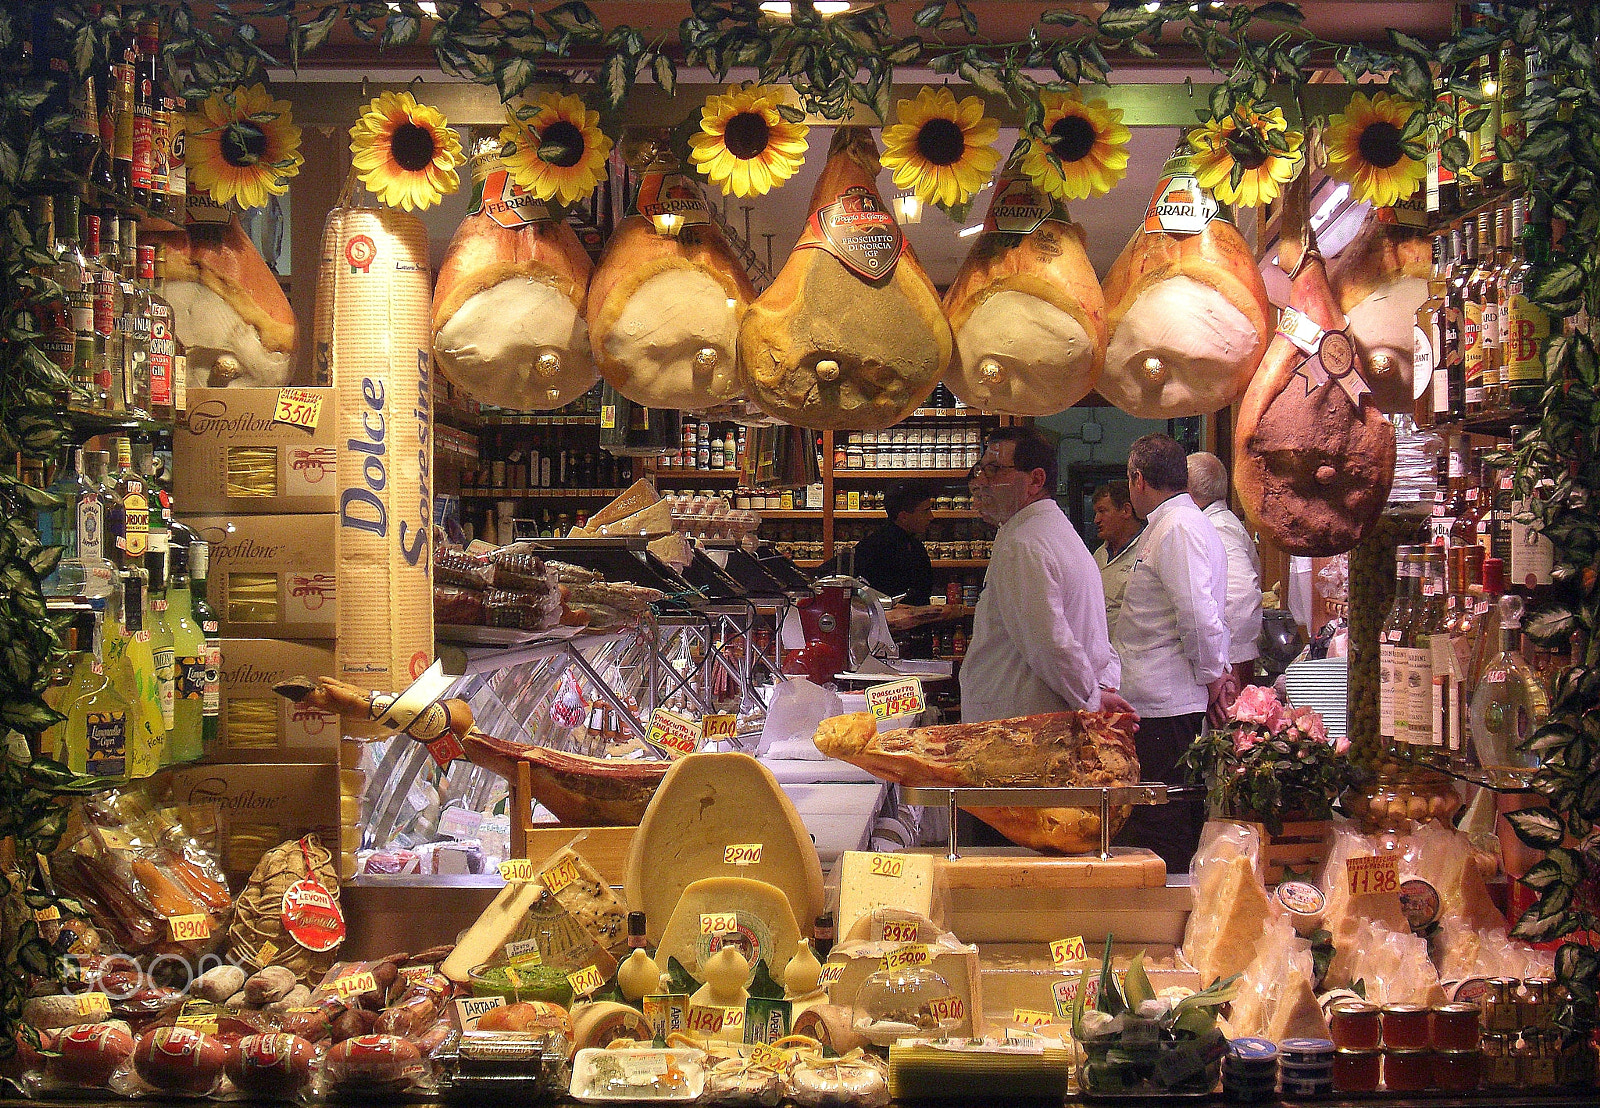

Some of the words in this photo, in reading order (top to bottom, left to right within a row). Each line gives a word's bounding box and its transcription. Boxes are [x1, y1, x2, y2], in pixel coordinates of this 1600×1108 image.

[842, 235, 893, 244] PROSCIUTTO
[849, 244, 858, 252] DI
[859, 242, 892, 250] NORCIA
[864, 250, 879, 258] IGP
[152, 365, 166, 377] GIN
[340, 377, 387, 538] Dolce
[400, 348, 430, 580] Soresina
[872, 686, 914, 699] PROSCIUTTO
[300, 892, 330, 904] LEVONI
